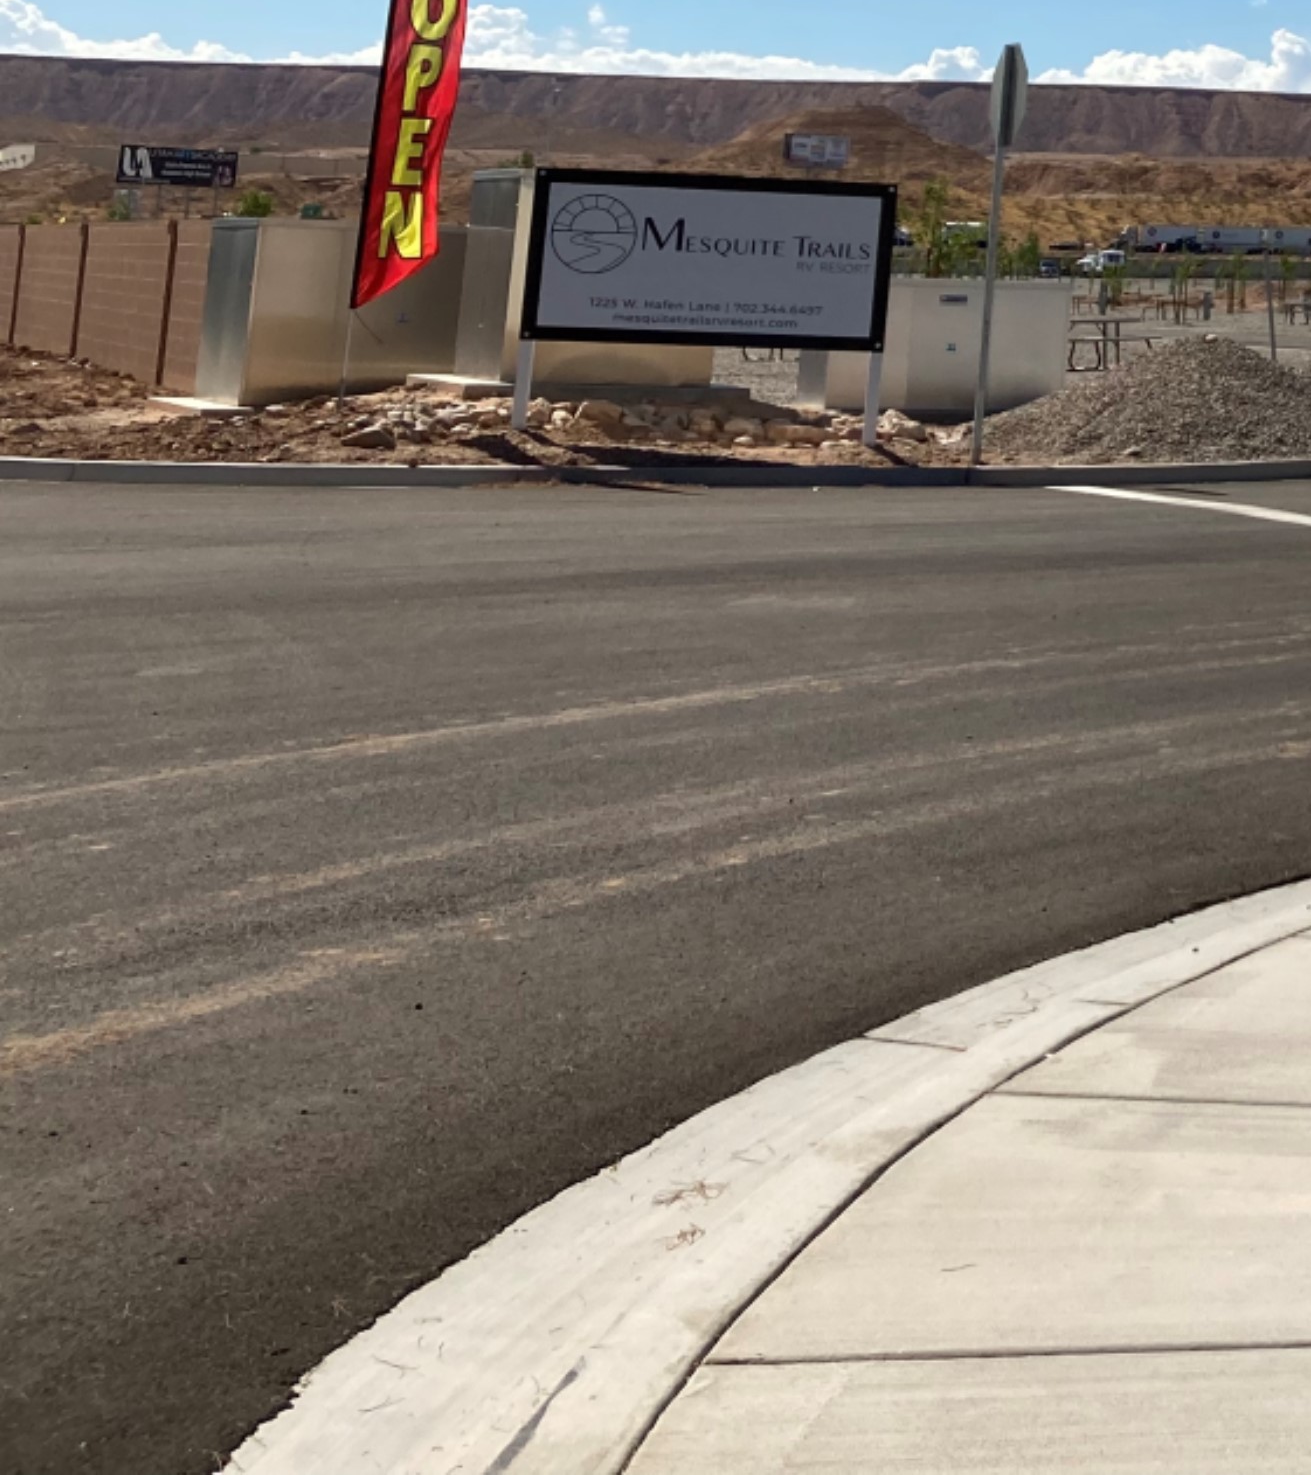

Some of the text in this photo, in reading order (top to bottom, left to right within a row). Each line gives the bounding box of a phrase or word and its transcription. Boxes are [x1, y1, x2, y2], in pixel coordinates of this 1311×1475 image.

[641, 217, 871, 260] MESQUITE TRAILS
[796, 261, 871, 274] RV RESORT
[688, 302, 721, 312] Lane
